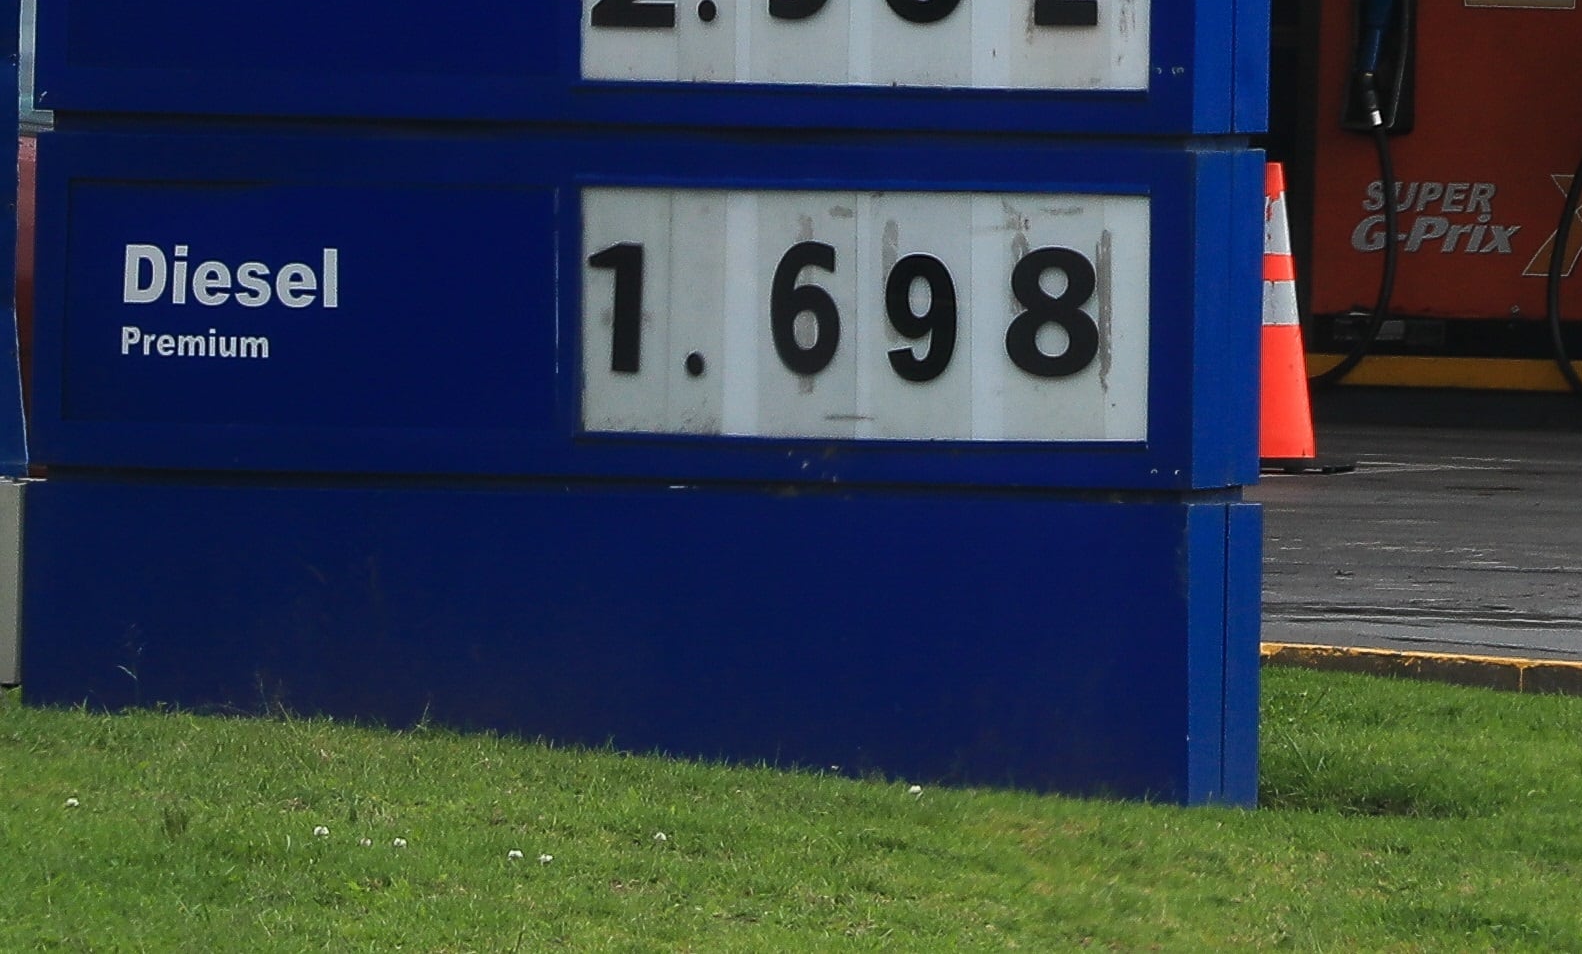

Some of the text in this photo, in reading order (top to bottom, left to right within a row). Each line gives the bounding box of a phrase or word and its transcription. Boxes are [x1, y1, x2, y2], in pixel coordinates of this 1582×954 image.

[1362, 180, 1496, 214] SUPER
[1350, 214, 1520, 255] G-Prix
[122, 243, 340, 309] Diesel
[588, 239, 1100, 383] 1.698
[120, 325, 270, 360] Premium
